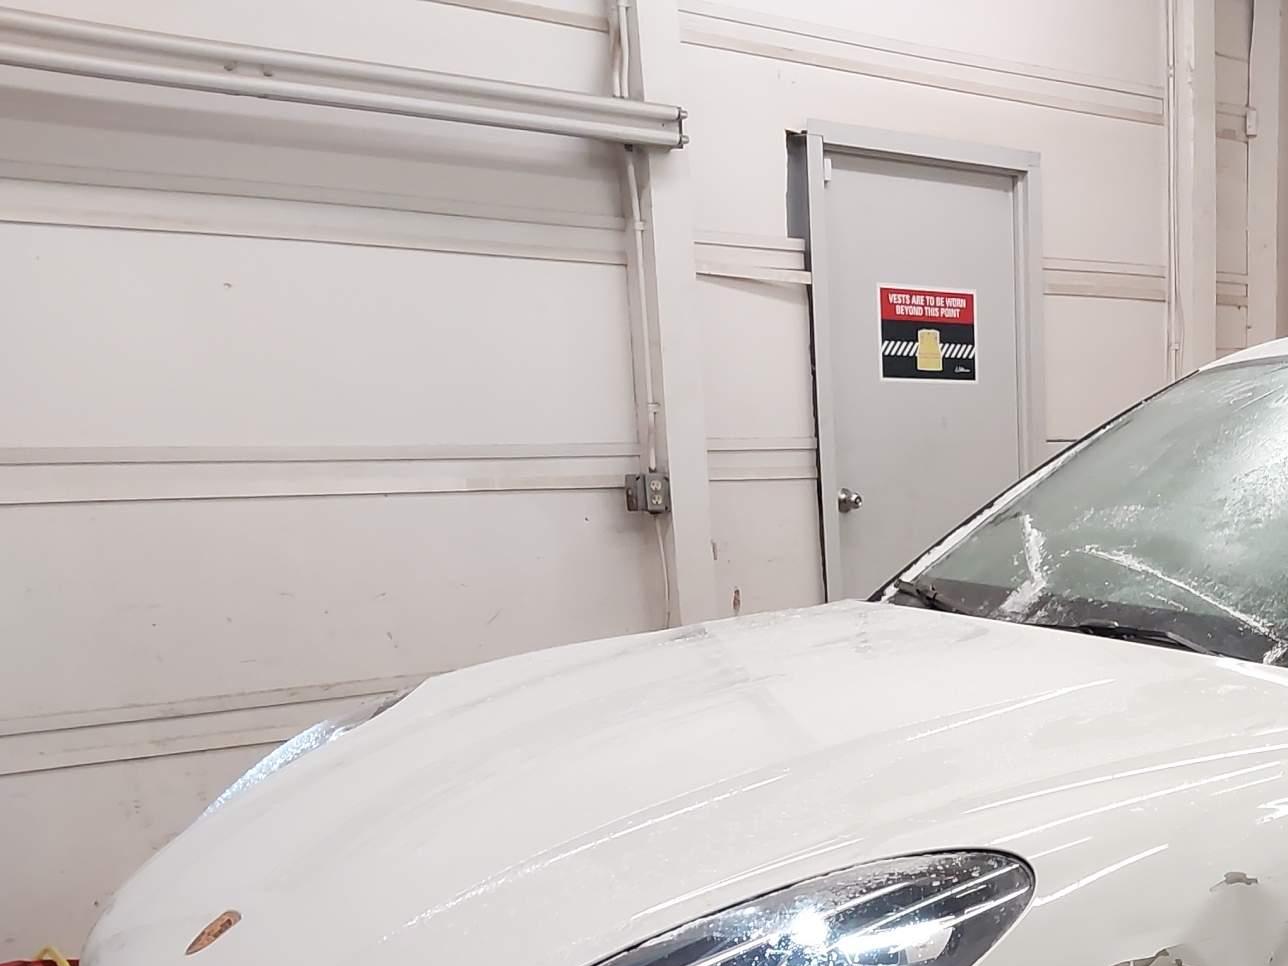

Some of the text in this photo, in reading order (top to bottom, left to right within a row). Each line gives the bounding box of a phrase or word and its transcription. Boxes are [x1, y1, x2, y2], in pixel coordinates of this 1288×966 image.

[888, 293, 966, 308] VESTS ARE TO BE WORN
[895, 306, 960, 318] BEYOND THIS POINT
